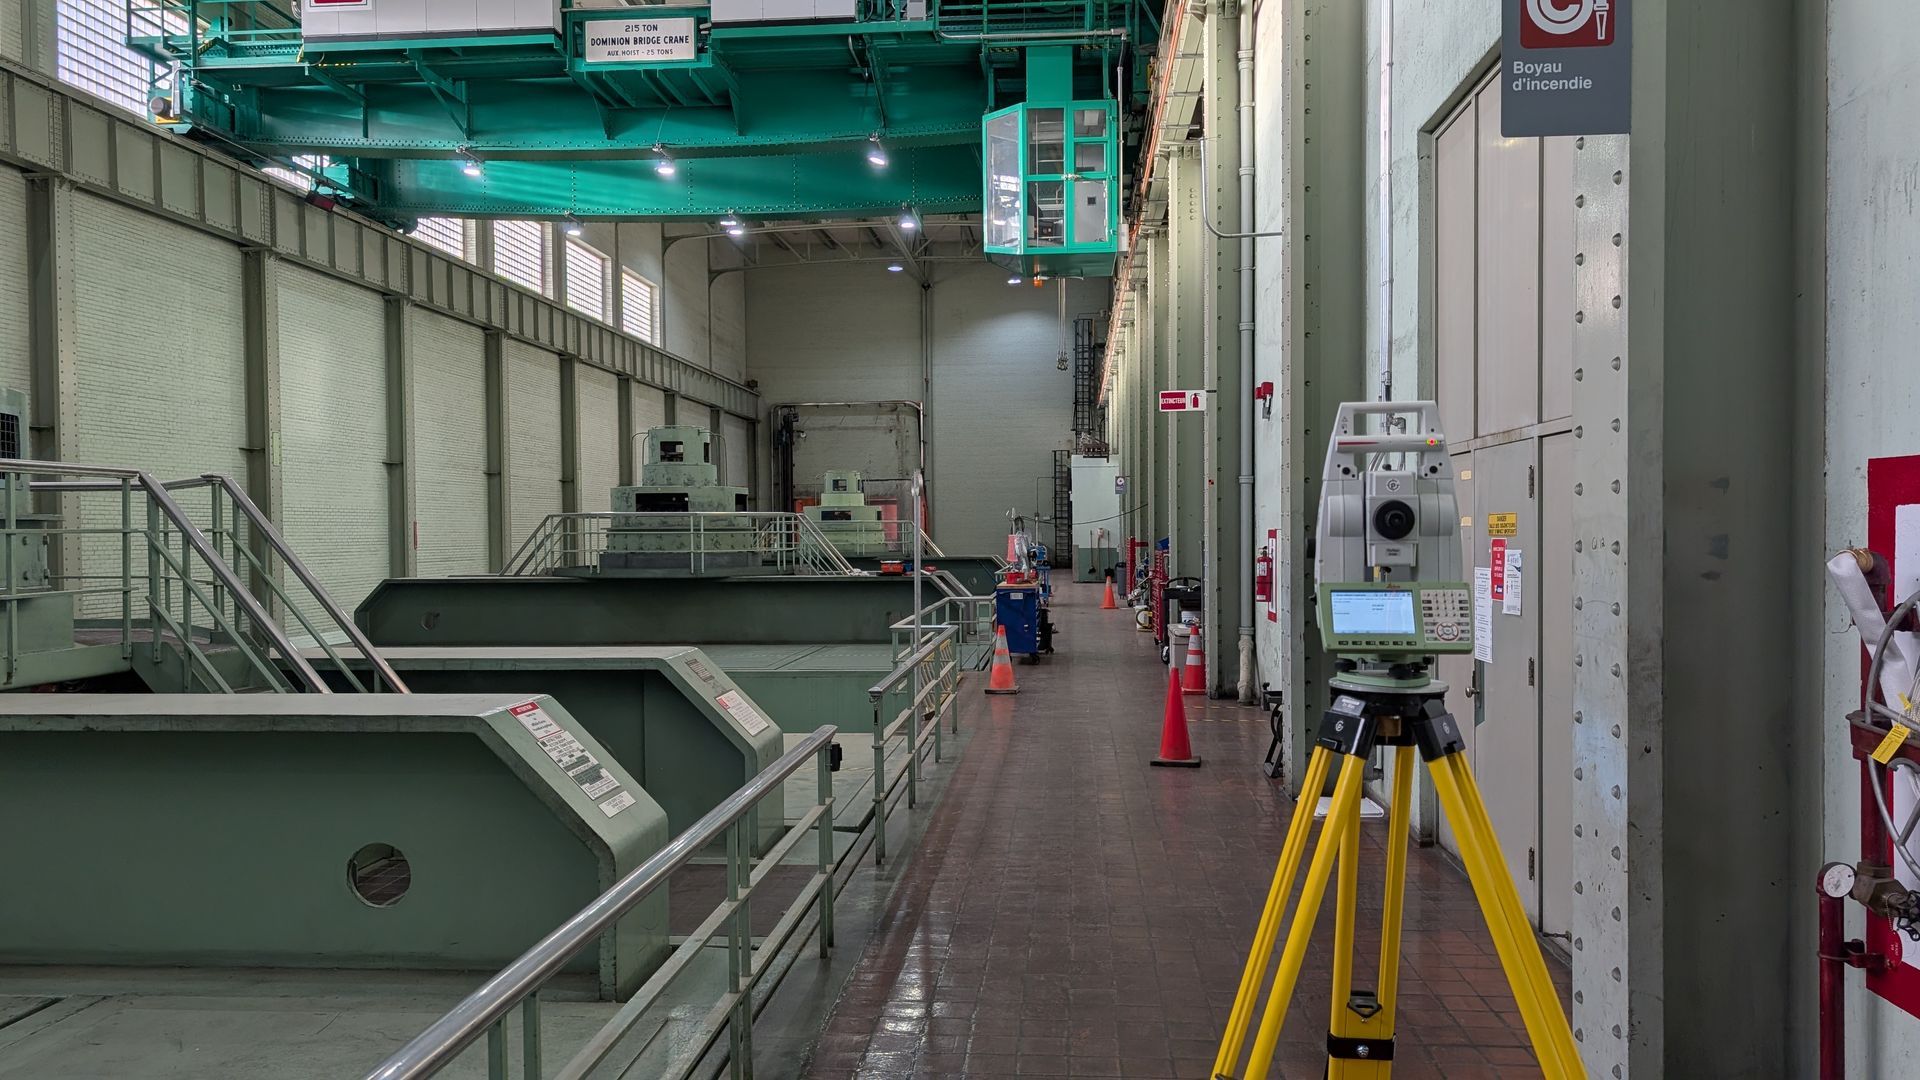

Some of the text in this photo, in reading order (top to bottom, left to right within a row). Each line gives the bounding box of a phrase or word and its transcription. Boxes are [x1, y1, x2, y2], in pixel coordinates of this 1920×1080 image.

[624, 24, 658, 33] 215 TON
[590, 35, 690, 47] DOMINION BRIDGE CRANE
[1513, 61, 1562, 76] Boyau
[1512, 76, 1593, 91] d'incendie
